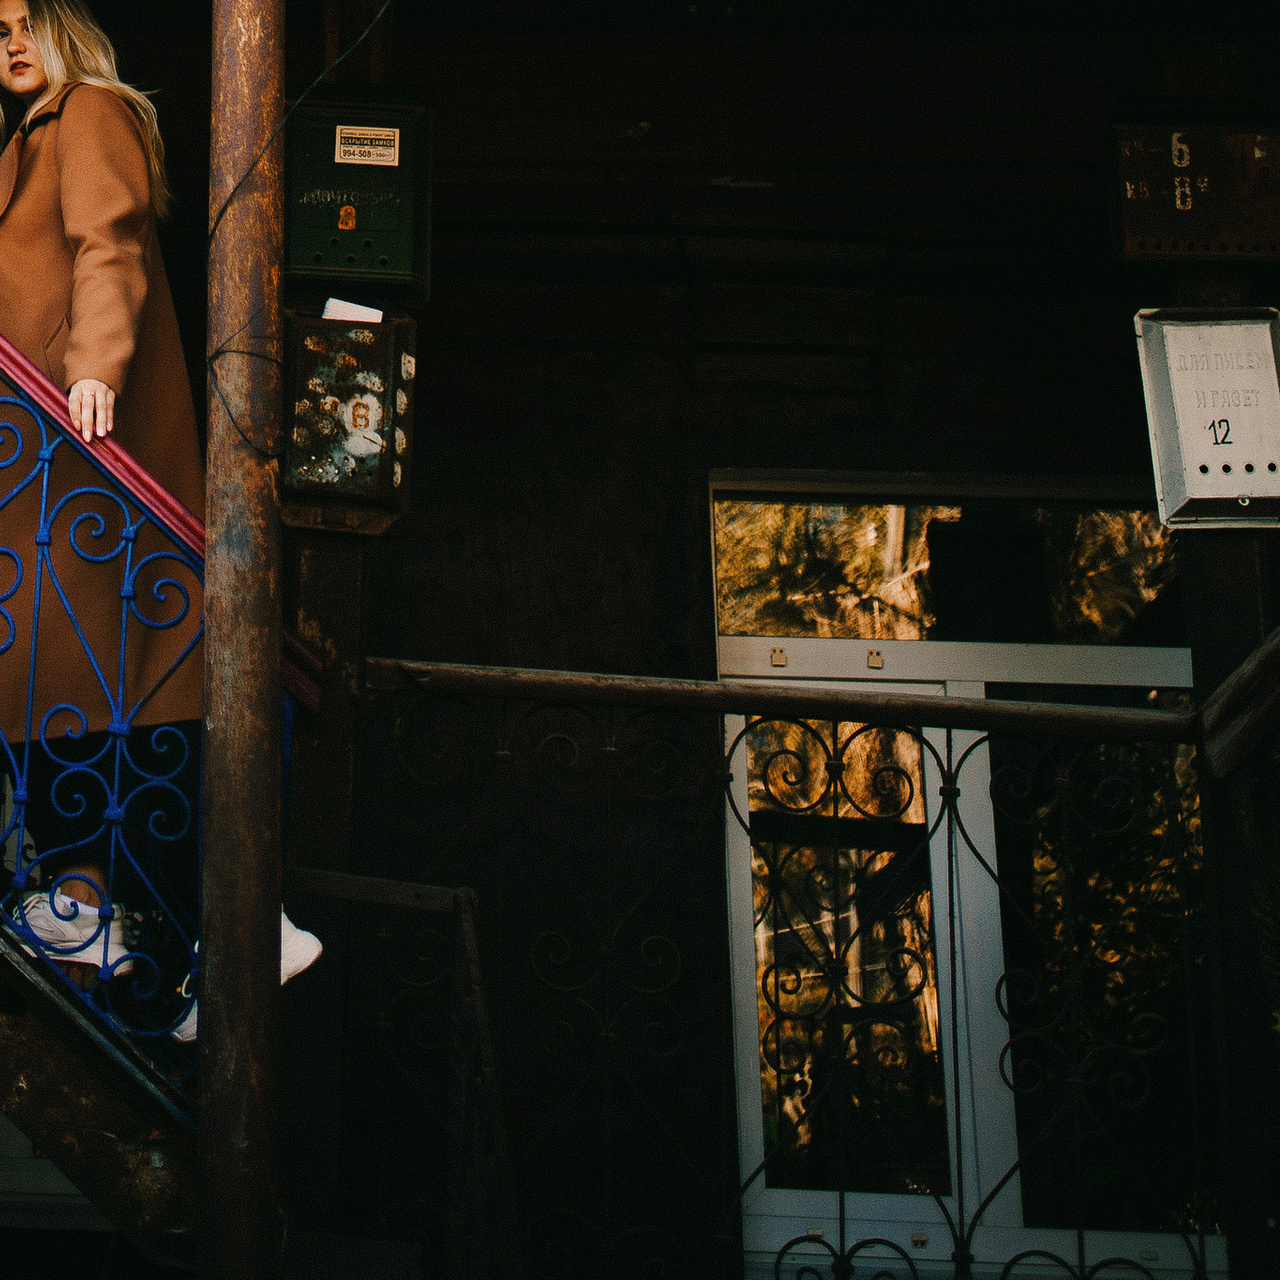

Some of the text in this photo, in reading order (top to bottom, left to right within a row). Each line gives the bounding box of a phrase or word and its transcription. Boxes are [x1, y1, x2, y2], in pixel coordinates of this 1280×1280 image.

[341, 137, 395, 147] ВСКРЫТИЕ ЗАМКОВ
[1172, 132, 1190, 167] 6
[342, 149, 372, 158] 994-508
[1177, 352, 1269, 371] ДЛЯ ПИСЕМ
[1195, 389, 1260, 408] И ГАЗЕТ
[1208, 418, 1234, 446] 12
